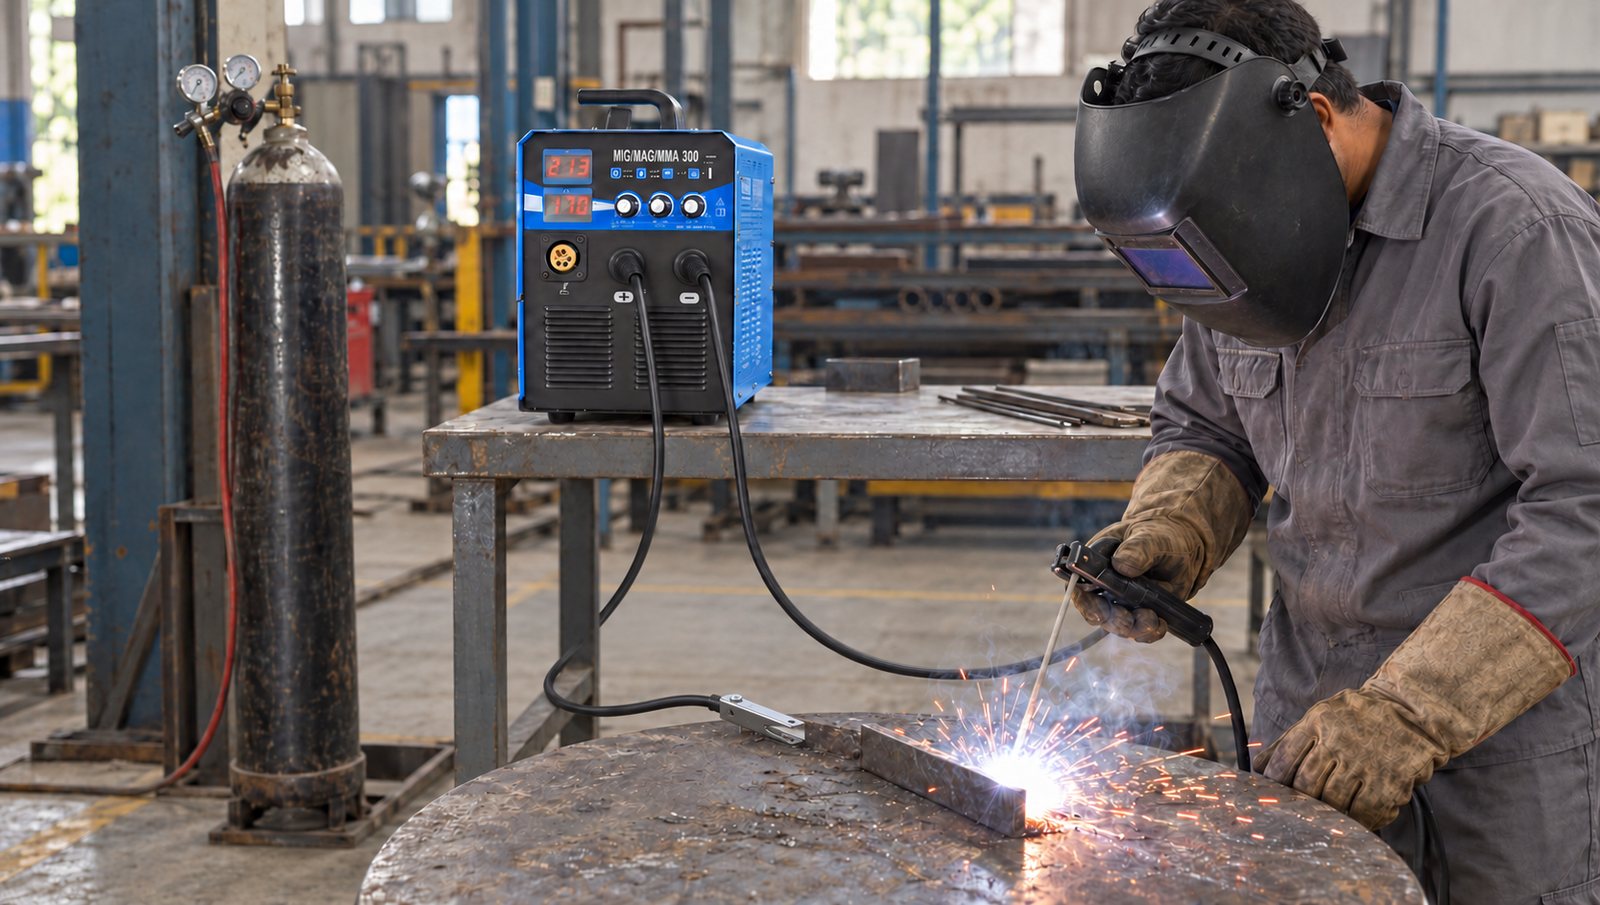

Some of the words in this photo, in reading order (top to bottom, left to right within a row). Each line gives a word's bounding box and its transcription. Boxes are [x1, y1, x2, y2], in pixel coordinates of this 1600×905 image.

[546, 155, 590, 177] 213
[613, 149, 679, 162] MIG/MAG/MMA
[682, 150, 699, 162] 300
[555, 194, 589, 215] 170
